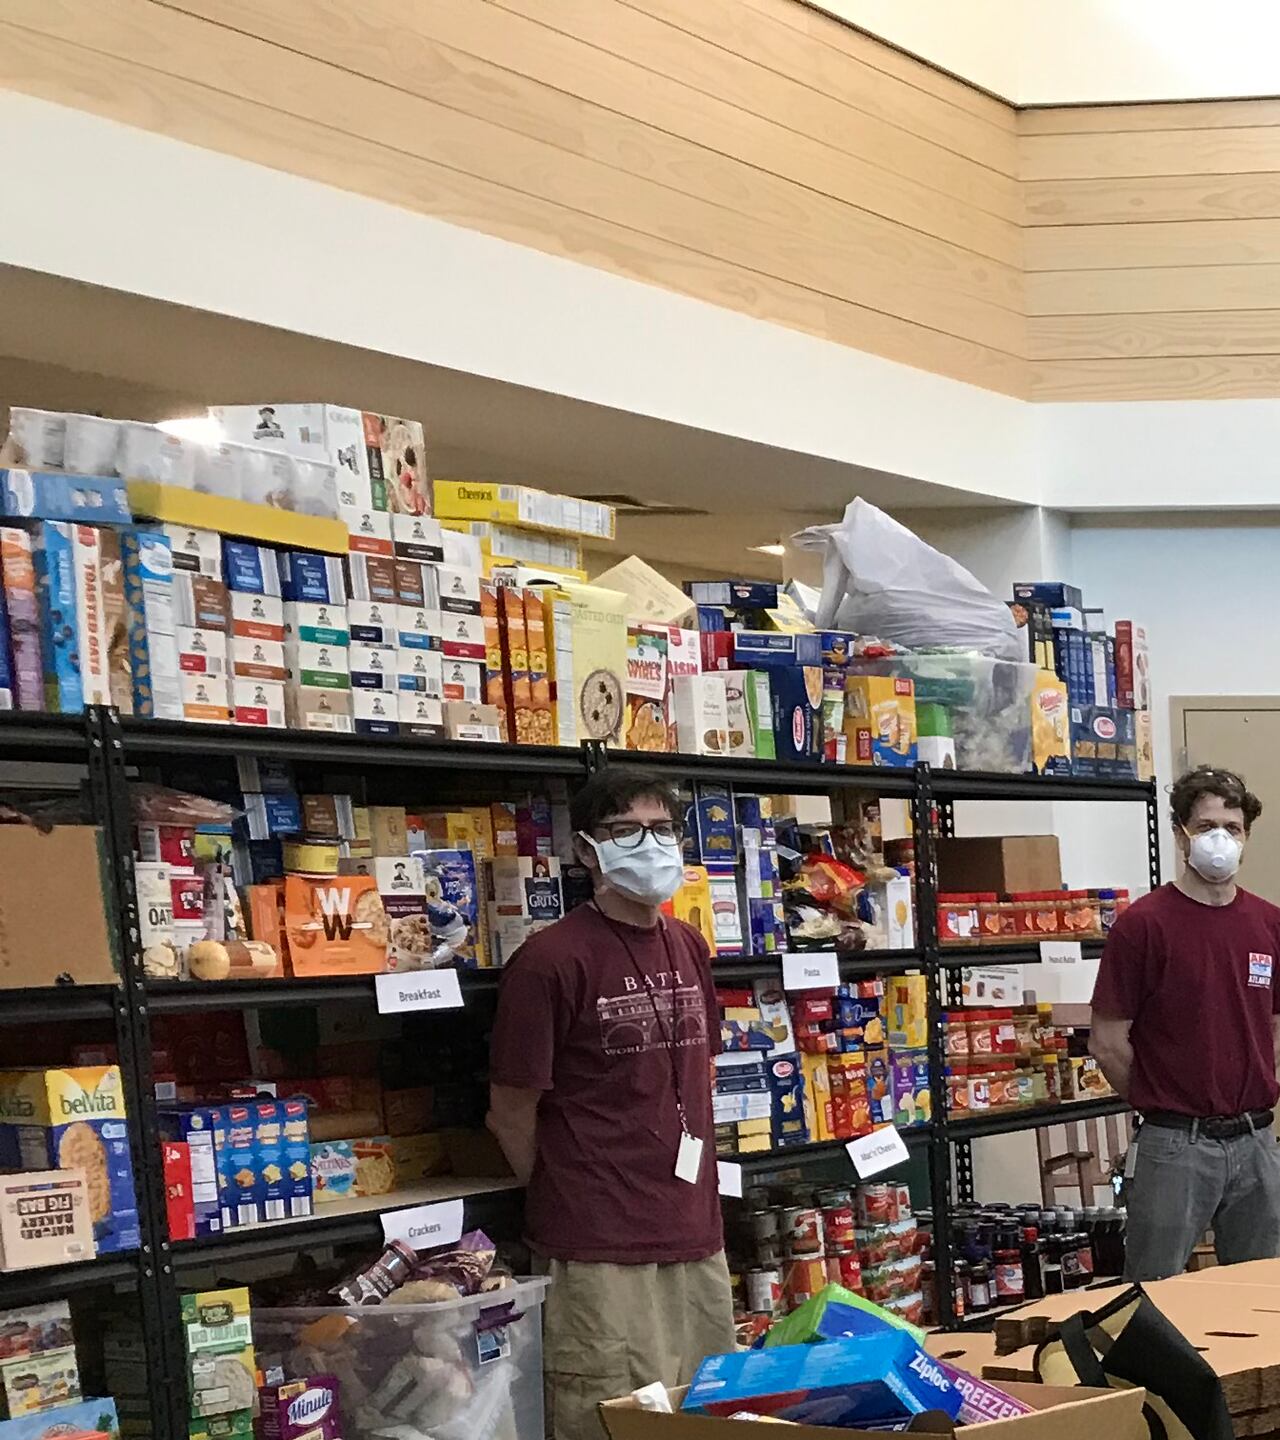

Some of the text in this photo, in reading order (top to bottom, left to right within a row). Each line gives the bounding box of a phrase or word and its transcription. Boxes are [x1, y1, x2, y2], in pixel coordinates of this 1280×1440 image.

[458, 487, 493, 501] Cheerios
[83, 563, 102, 676] TOASTED OATS
[528, 892, 560, 909] GRITS
[399, 987, 441, 1003] Breakfast
[60, 1089, 117, 1115] belVita
[407, 1222, 442, 1238] Crackers
[909, 1350, 951, 1393] Ziploc
[289, 1388, 333, 1422] Minute
